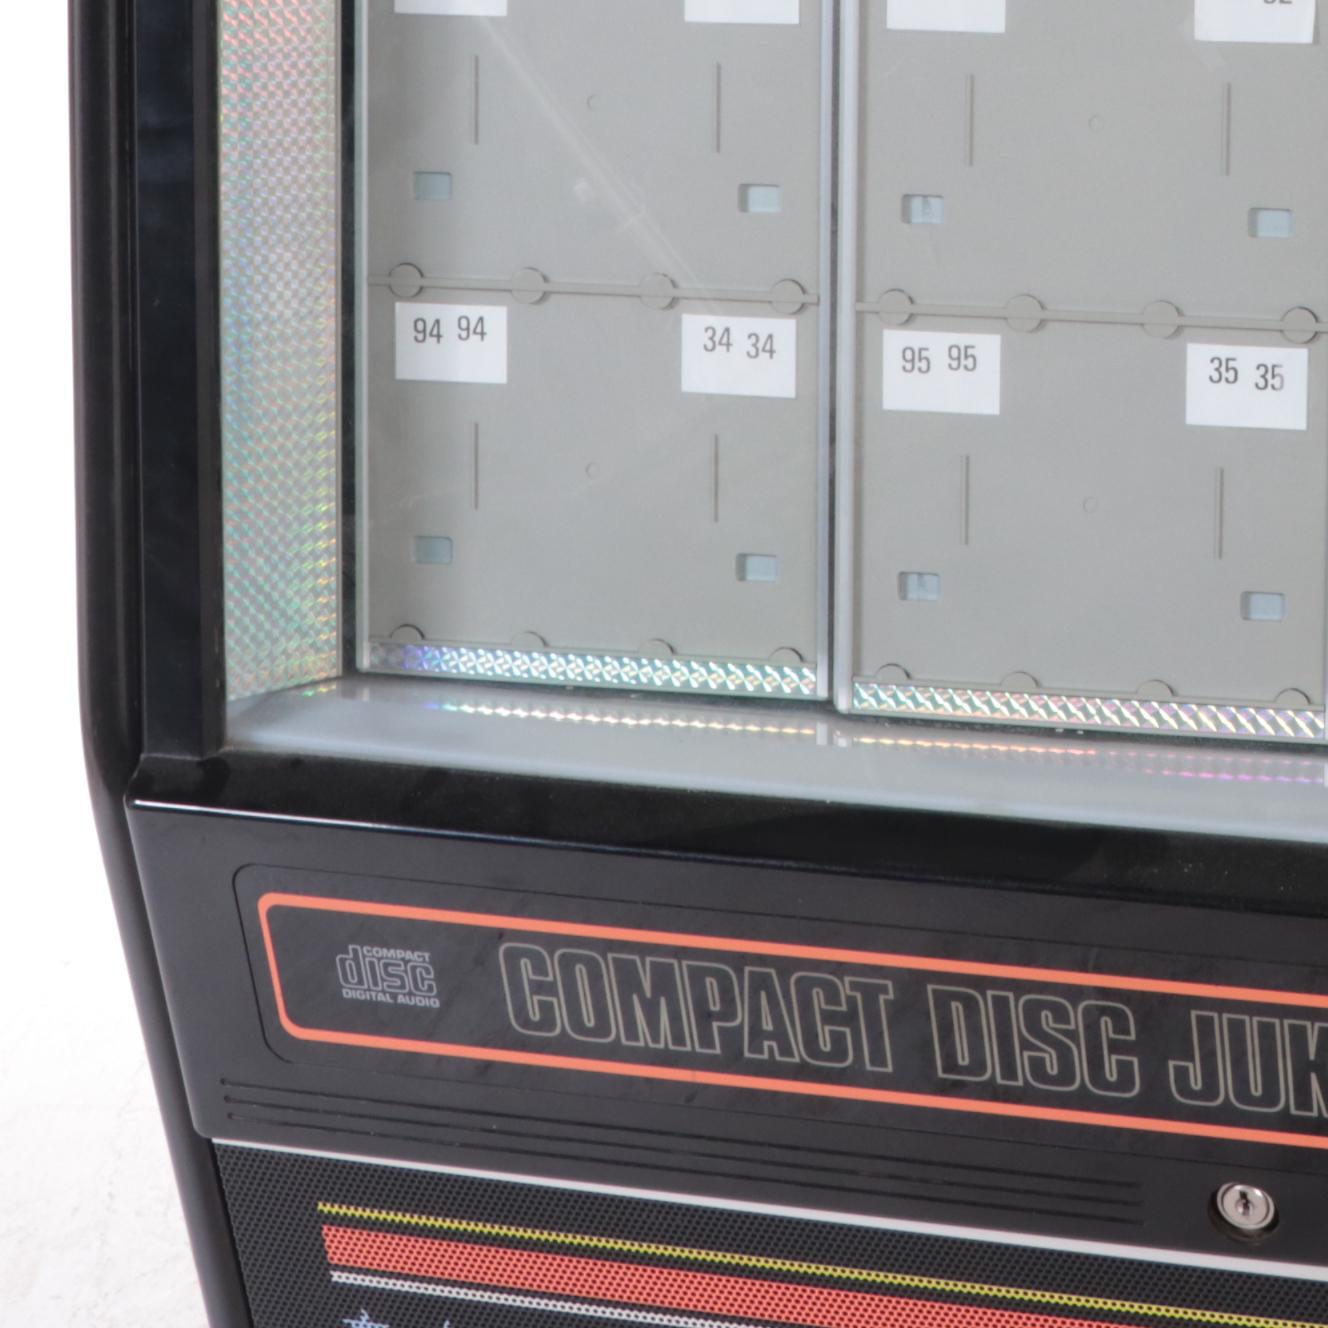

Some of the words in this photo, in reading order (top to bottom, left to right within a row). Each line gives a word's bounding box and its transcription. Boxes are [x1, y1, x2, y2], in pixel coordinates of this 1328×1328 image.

[413, 317, 443, 344] 94
[457, 315, 487, 341] 94
[703, 326, 733, 352] 34
[746, 333, 776, 359] 34
[902, 346, 931, 374] 95
[948, 344, 977, 372] 95
[1209, 357, 1238, 384] 35
[1254, 363, 1284, 391] 35
[363, 945, 430, 962] COMPACT
[342, 988, 394, 1003] DIGITAL
[397, 994, 440, 1008] AUDIO
[500, 943, 894, 1072] COMPACT
[928, 983, 1142, 1097] DISC
